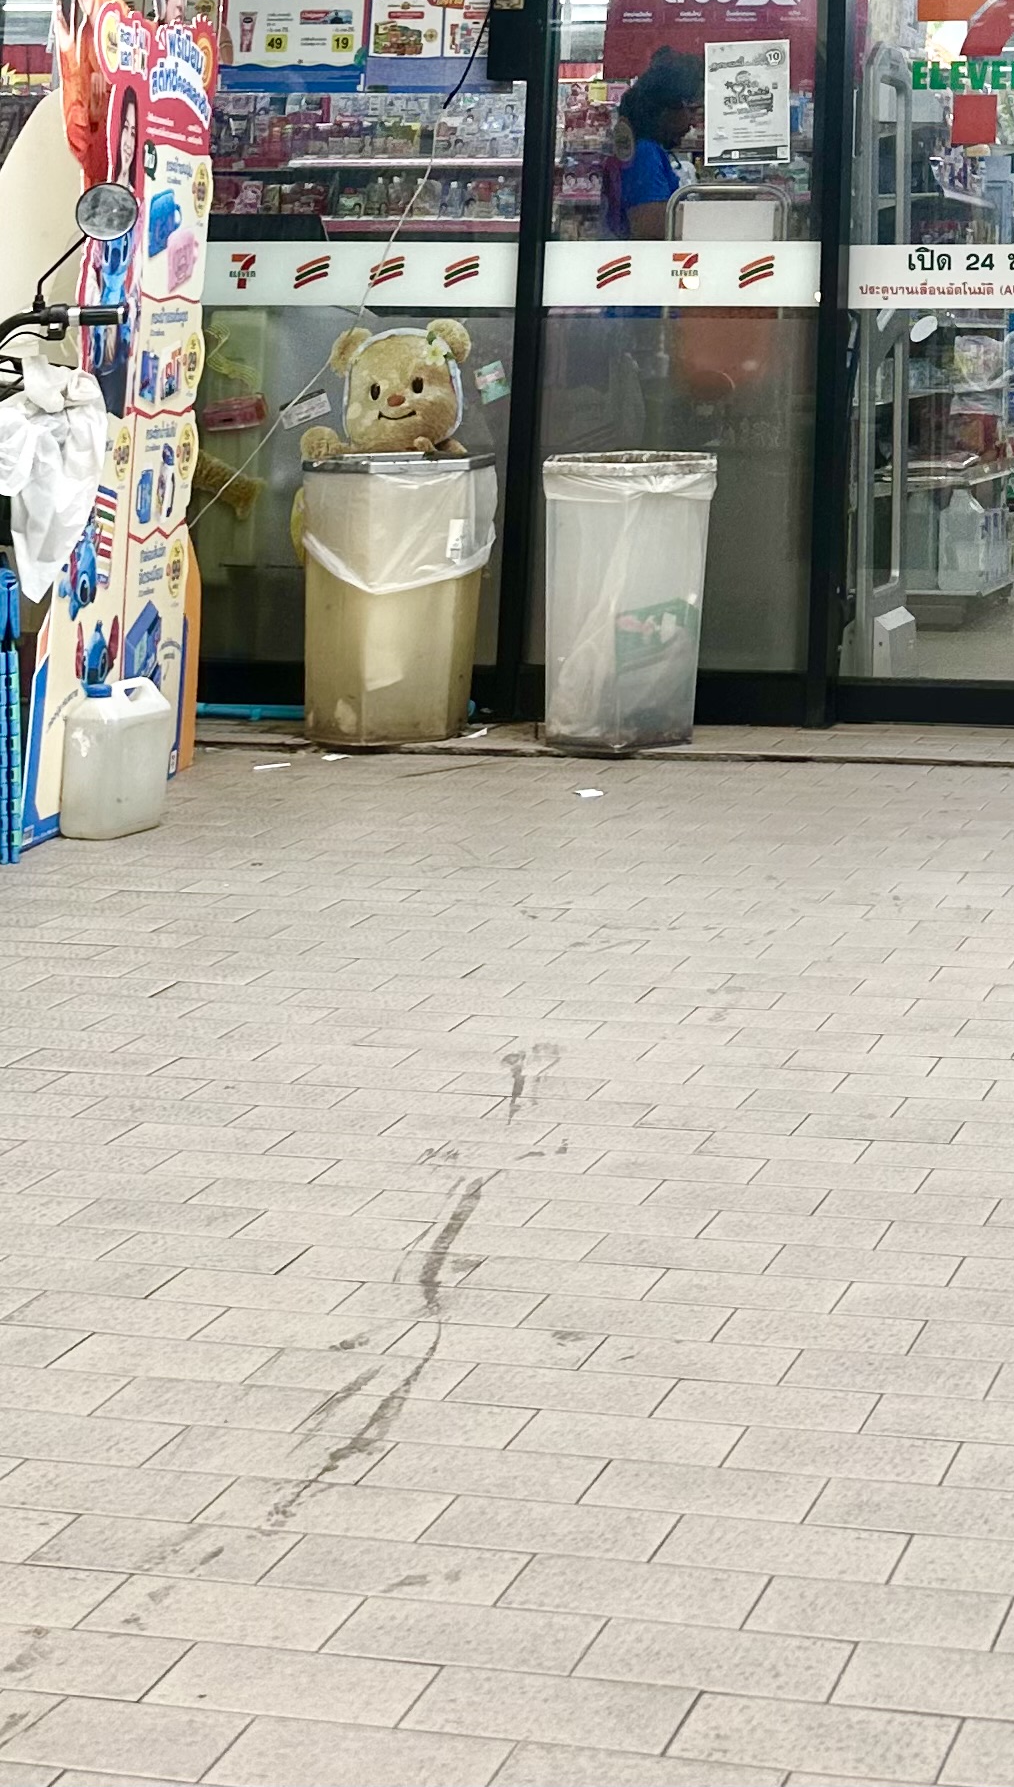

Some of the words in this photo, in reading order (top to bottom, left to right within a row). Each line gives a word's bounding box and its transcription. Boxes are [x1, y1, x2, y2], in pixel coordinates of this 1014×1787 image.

[267, 37, 283, 49] 49
[335, 37, 349, 49] 19
[908, 247, 951, 271] เปิด
[966, 253, 995, 271] 24
